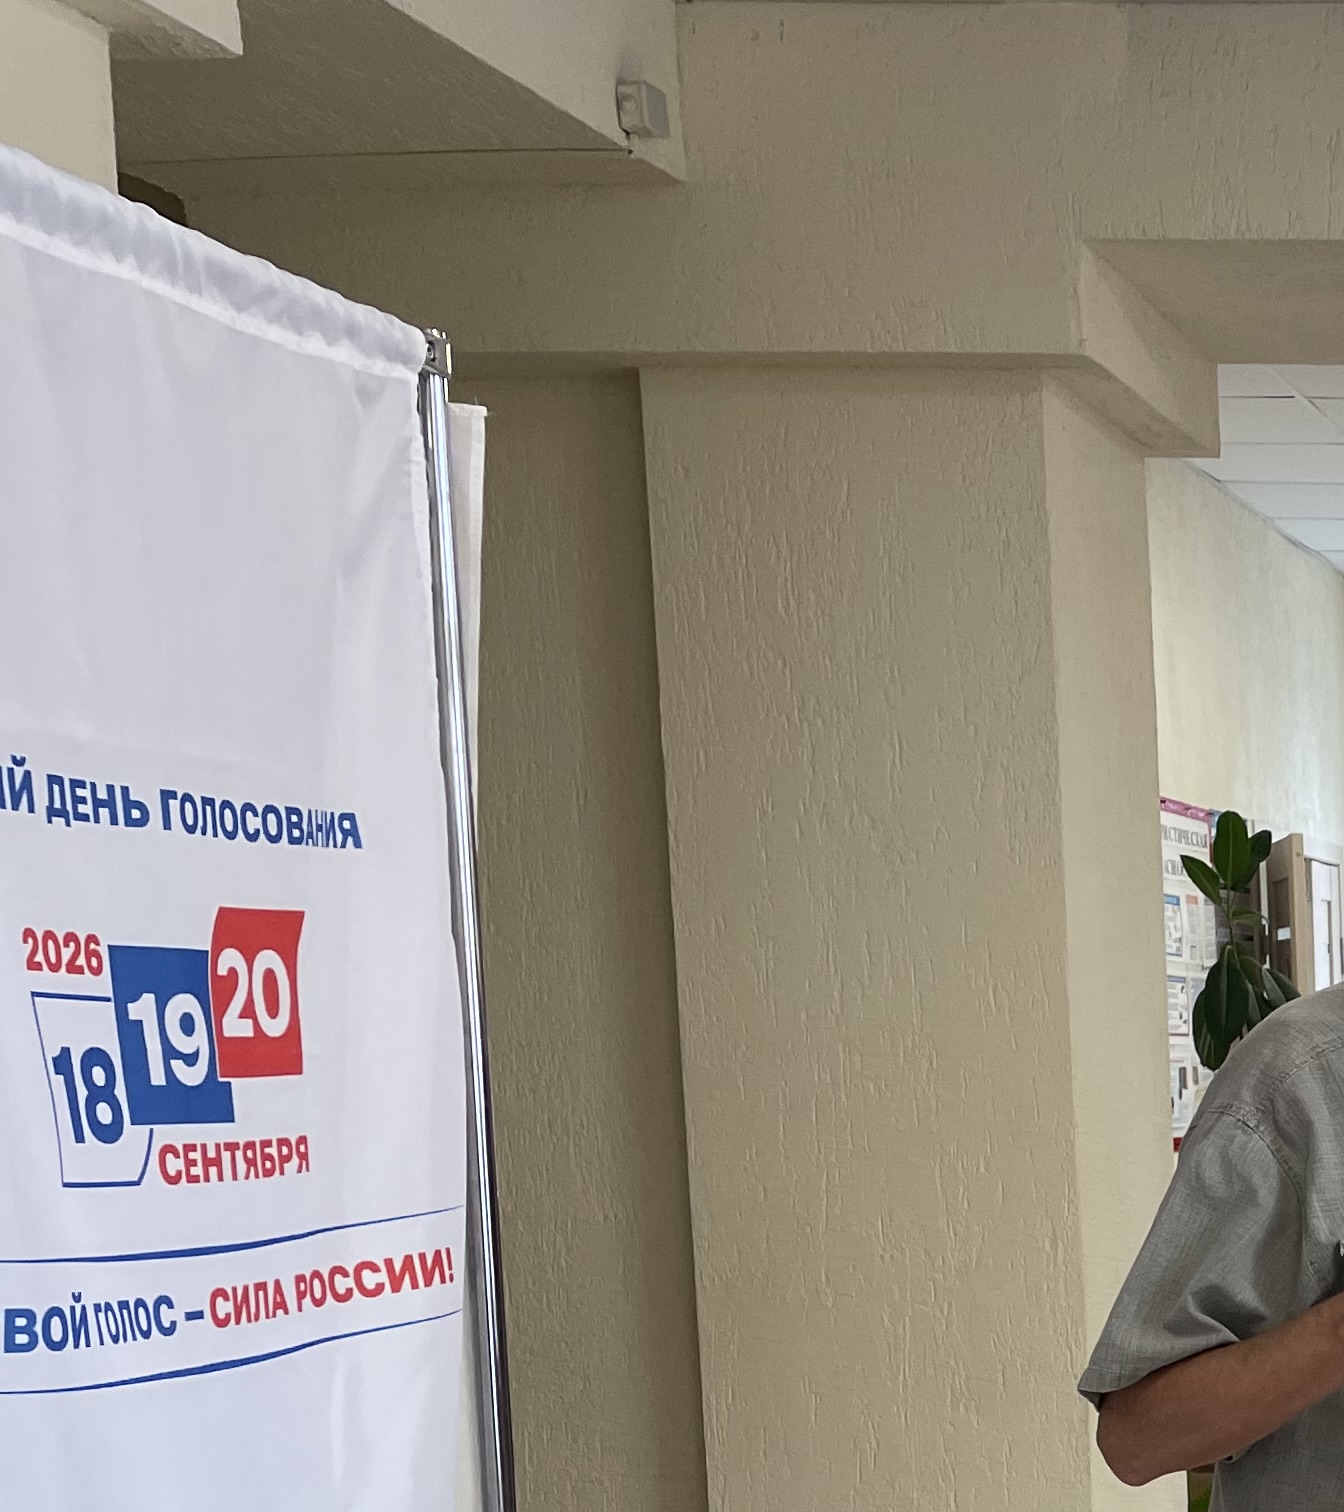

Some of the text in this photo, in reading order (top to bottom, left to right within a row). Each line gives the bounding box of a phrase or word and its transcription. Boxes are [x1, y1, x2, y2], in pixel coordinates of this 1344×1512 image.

[46, 774, 150, 828] ДЕНЬ
[159, 788, 363, 849] ГОЛОСОВАНИЯ
[22, 928, 103, 976] 2026
[215, 946, 291, 1039] 20
[126, 991, 210, 1088] 19
[51, 1045, 125, 1145] 18
[158, 1136, 309, 1185] СЕНТЯБРЯ
[93, 1294, 177, 1346] ГОЛОС
[209, 1280, 288, 1328] СИЛА
[295, 1248, 454, 1312] РОССИИ!
